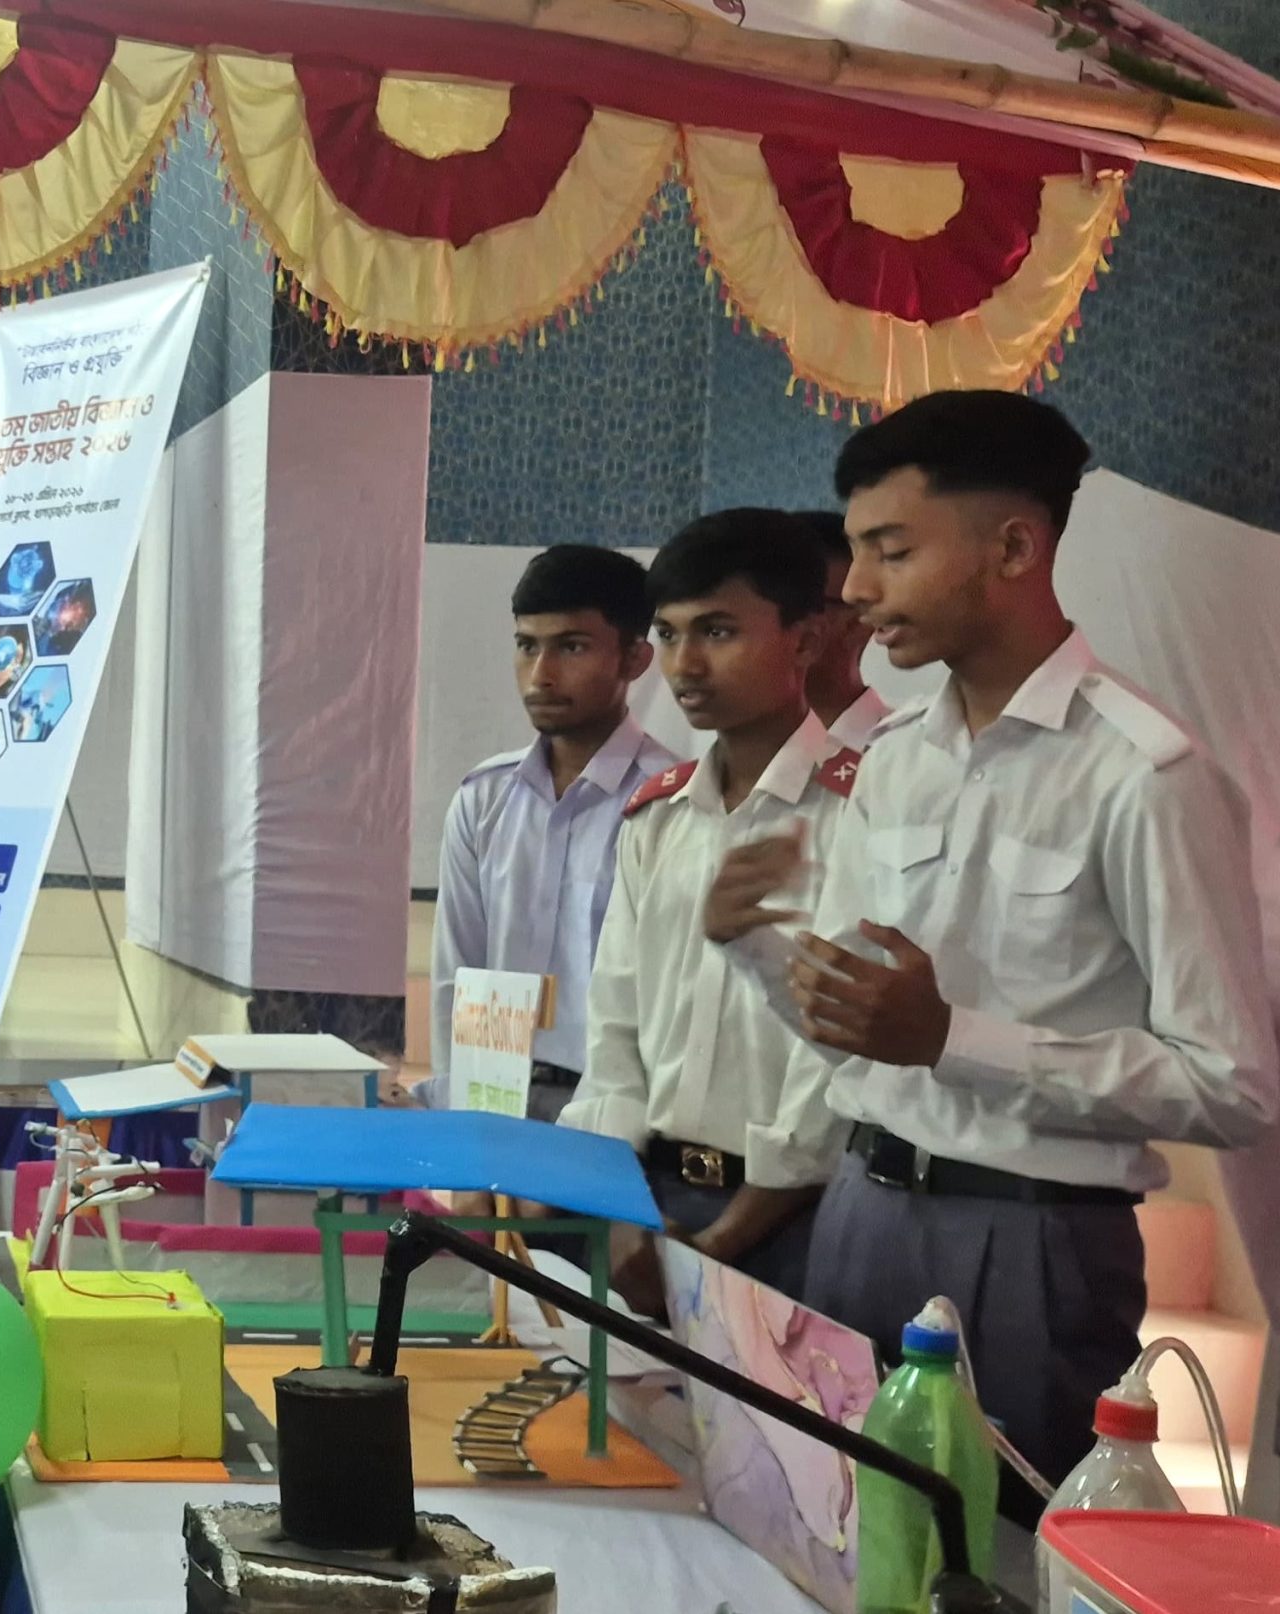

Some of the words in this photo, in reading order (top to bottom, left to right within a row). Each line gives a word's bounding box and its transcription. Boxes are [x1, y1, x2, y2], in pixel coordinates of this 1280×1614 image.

[69, 360, 80, 375] ও
[29, 400, 81, 433] জাতীয়
[140, 394, 155, 416] ও
